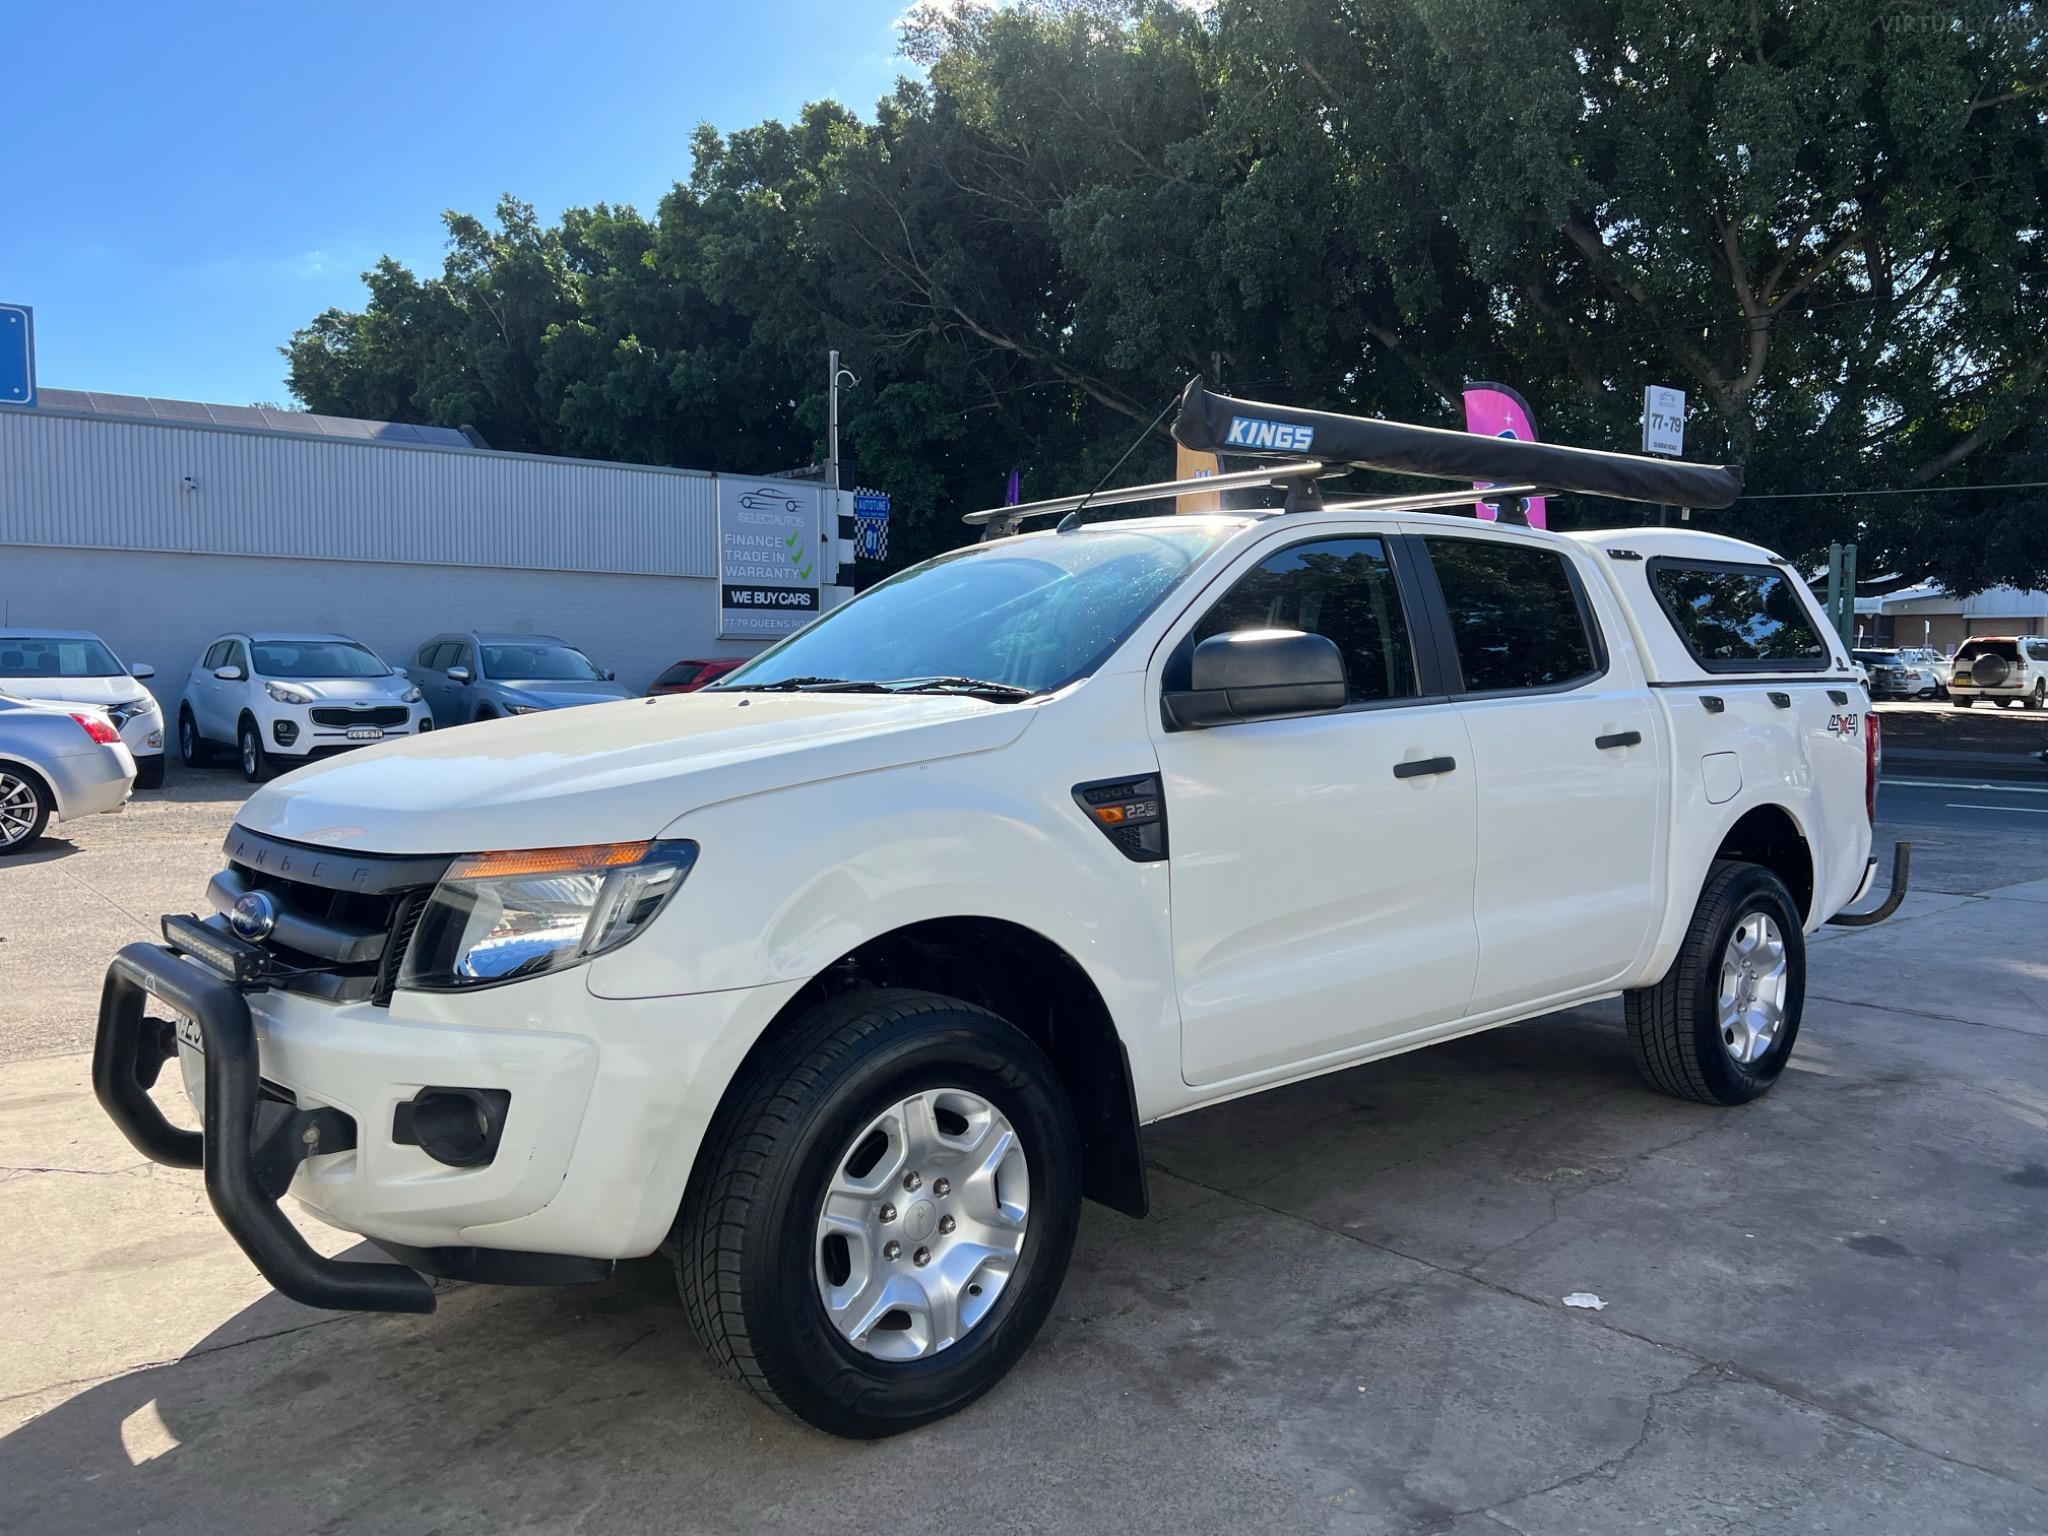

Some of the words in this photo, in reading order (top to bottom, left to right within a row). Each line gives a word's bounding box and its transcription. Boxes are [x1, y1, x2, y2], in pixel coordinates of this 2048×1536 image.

[1228, 420, 1314, 449] KINGS
[724, 533, 783, 548] FINANCE
[724, 550, 770, 562] TRADE
[772, 551, 785, 563] IN
[724, 565, 800, 579] WARRANTY
[731, 591, 752, 603] WE
[754, 592, 779, 605] BUY
[779, 592, 811, 606] CARS
[724, 618, 748, 627] 77-79
[750, 618, 790, 629] QUEENS
[235, 842, 372, 892] ANGER
